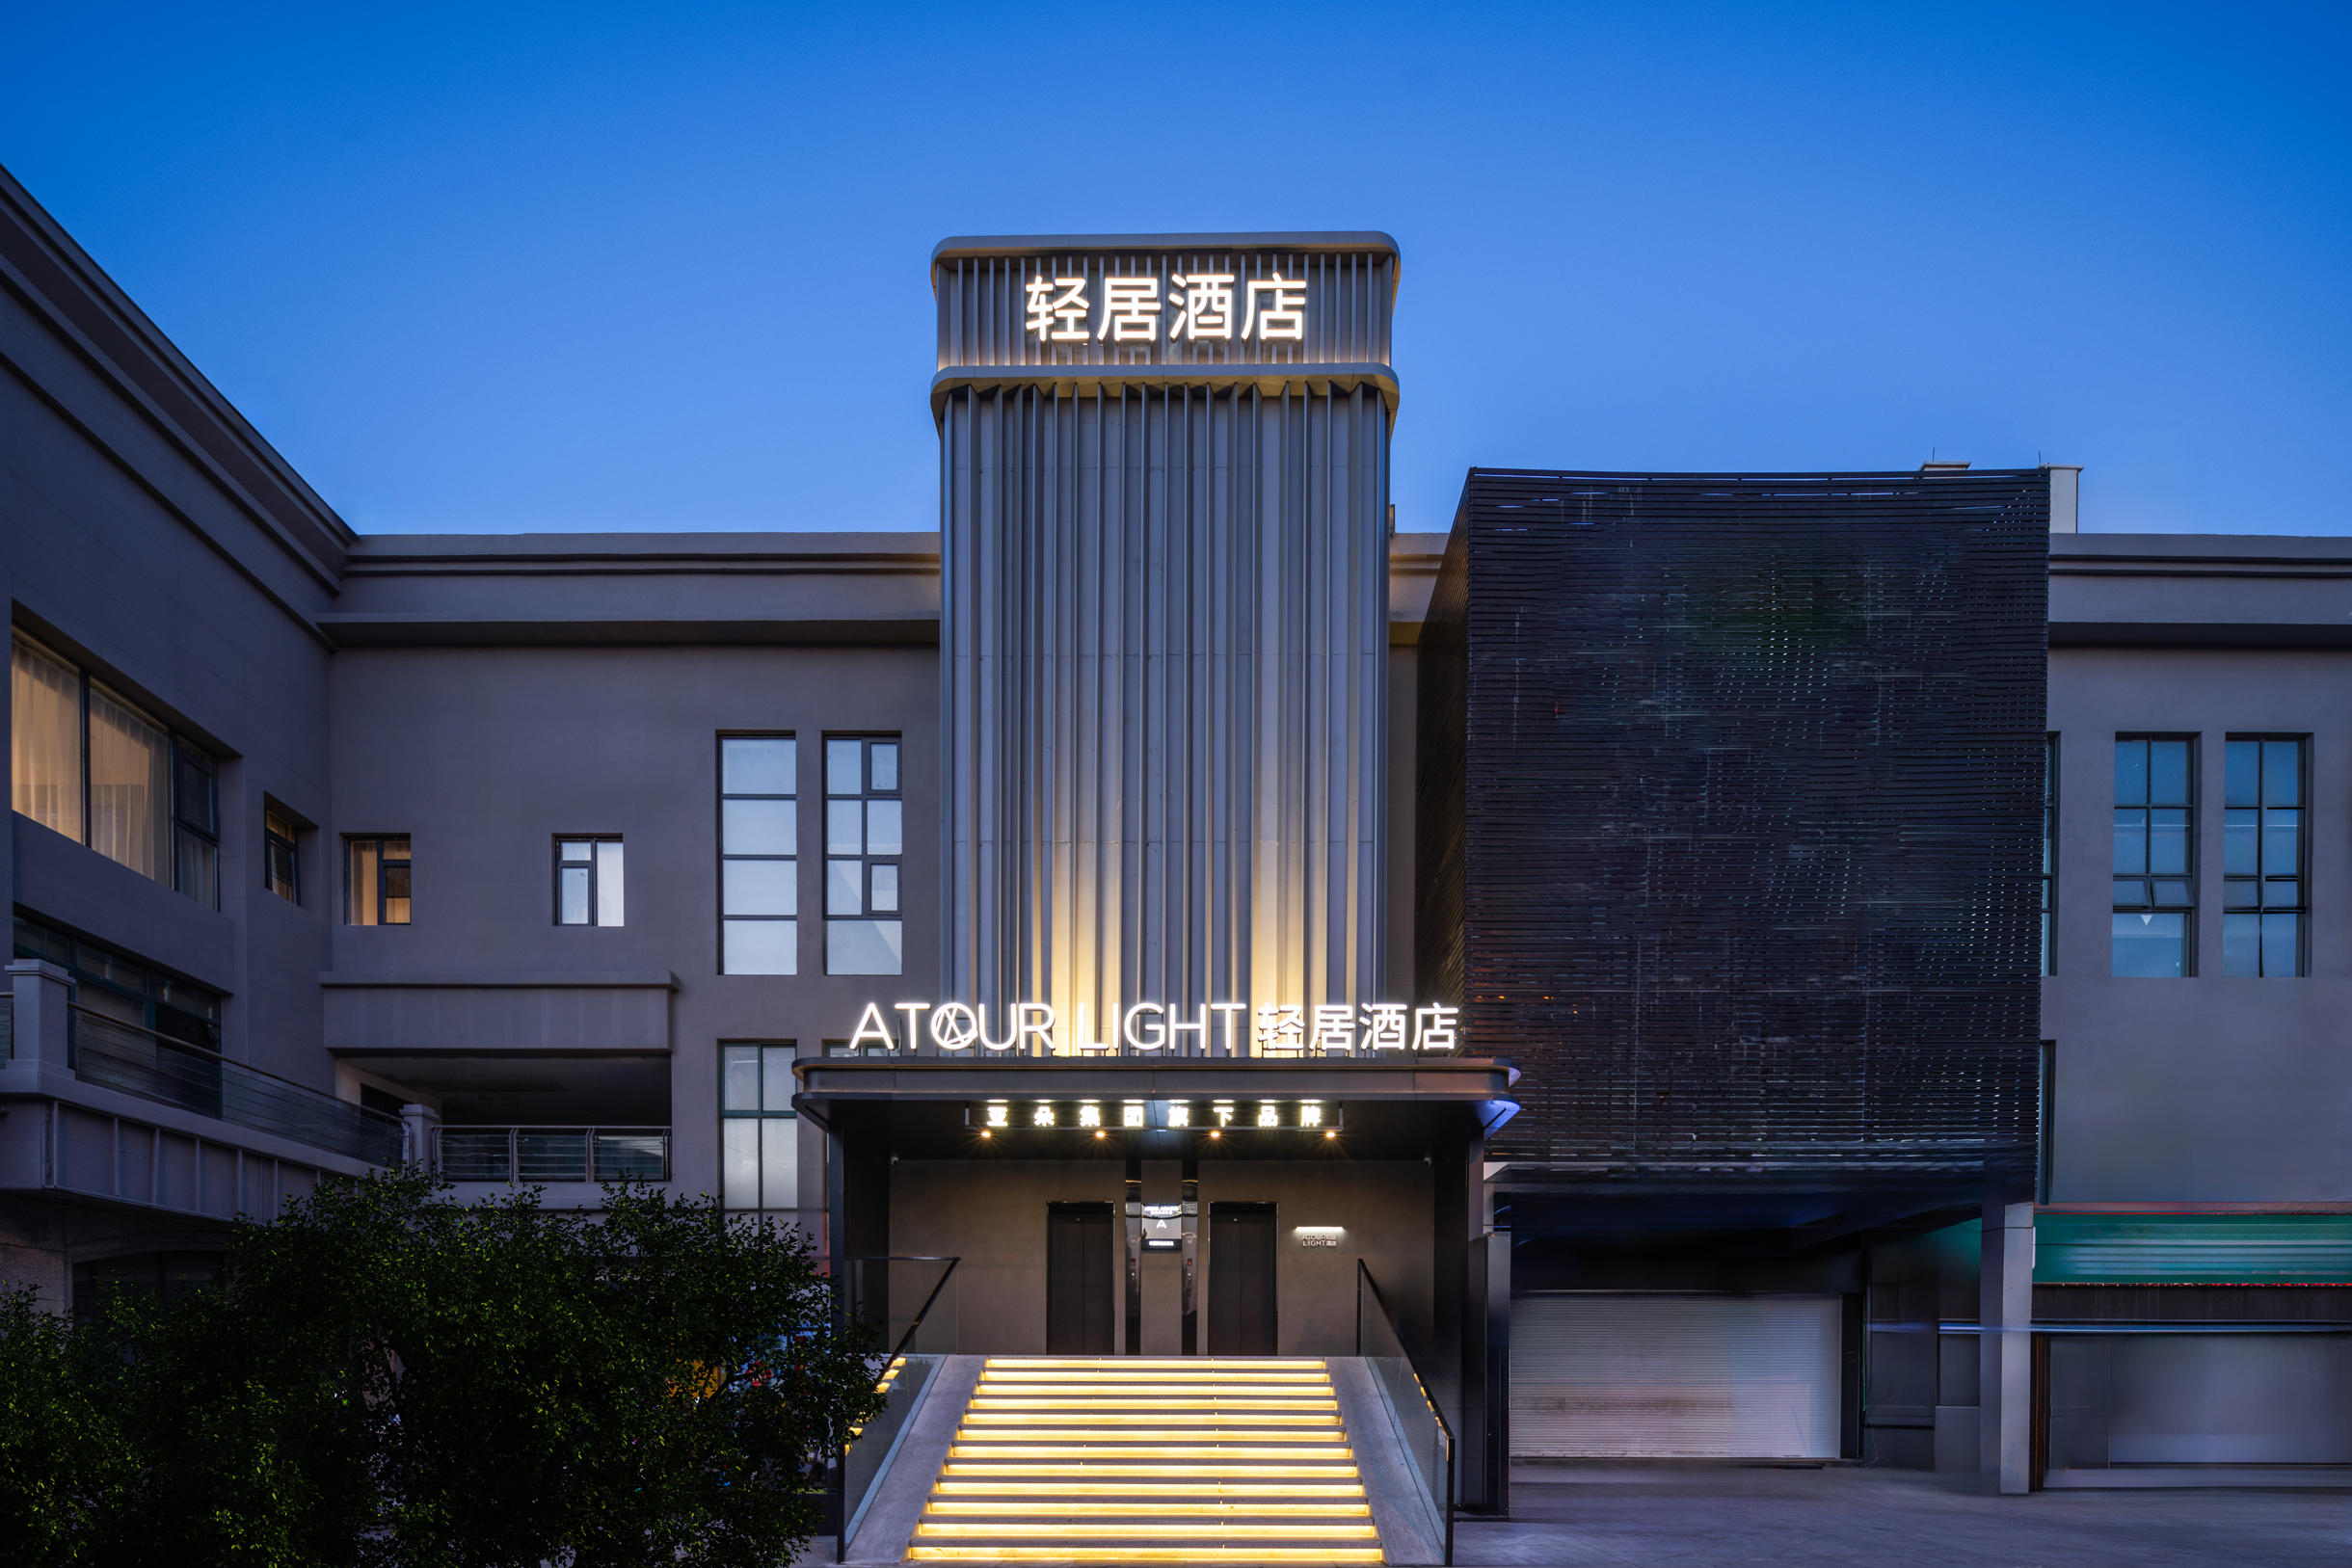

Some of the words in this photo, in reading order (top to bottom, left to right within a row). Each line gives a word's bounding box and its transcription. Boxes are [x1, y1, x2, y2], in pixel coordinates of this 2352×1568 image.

[1026, 272, 1307, 342] 轻居酒店
[849, 1002, 1056, 1050] ATOUR
[1079, 1002, 1247, 1050] LIGHT
[1258, 1002, 1459, 1050] 轻居酒店
